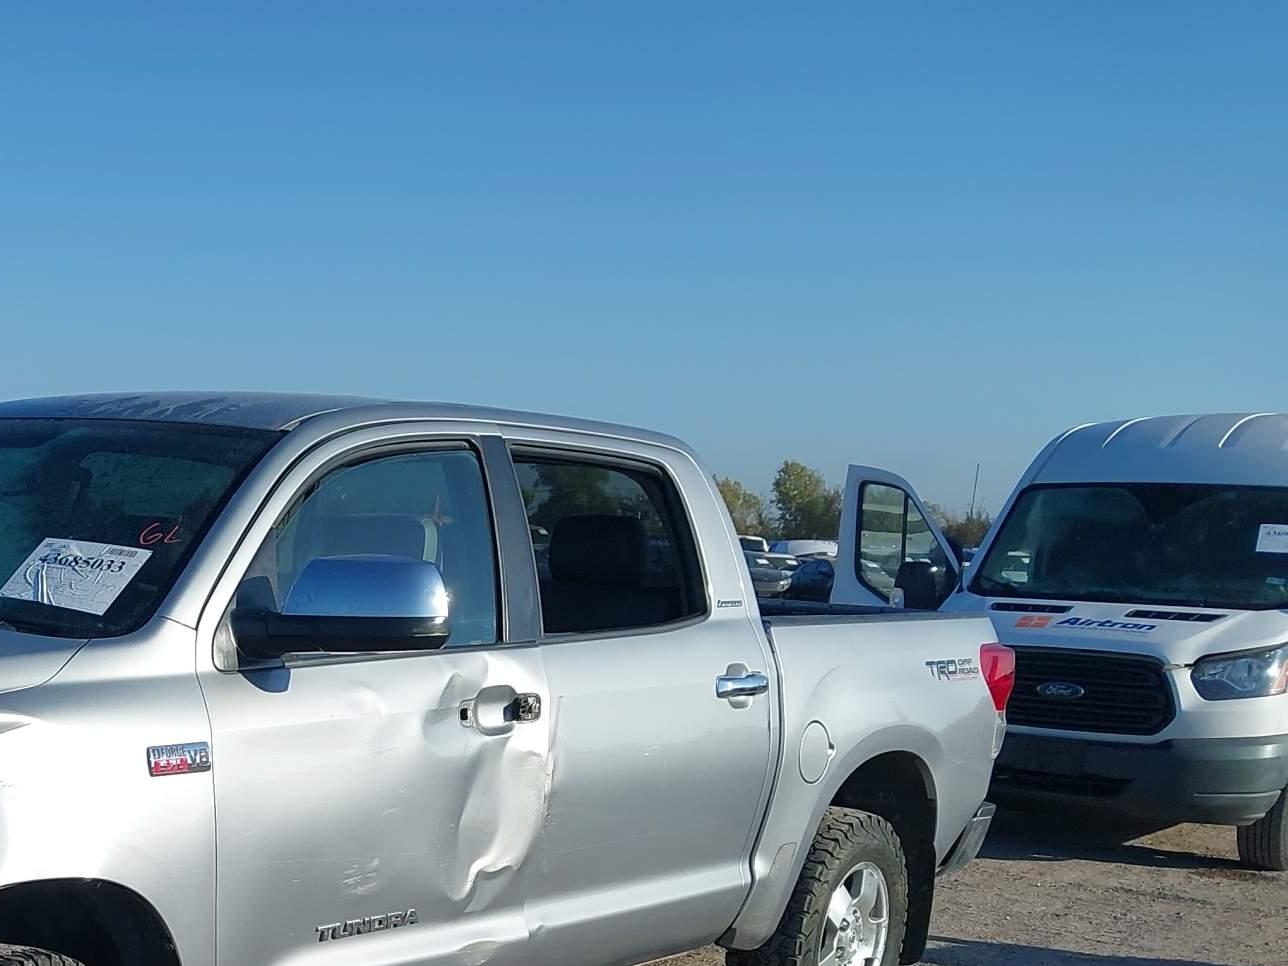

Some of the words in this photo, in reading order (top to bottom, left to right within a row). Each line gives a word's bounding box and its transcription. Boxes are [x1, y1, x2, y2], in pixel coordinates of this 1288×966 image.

[38, 552, 126, 573] 43685033
[1056, 617, 1157, 631] Airtron
[925, 659, 958, 681] TRD
[315, 908, 419, 942] TUNDRA
